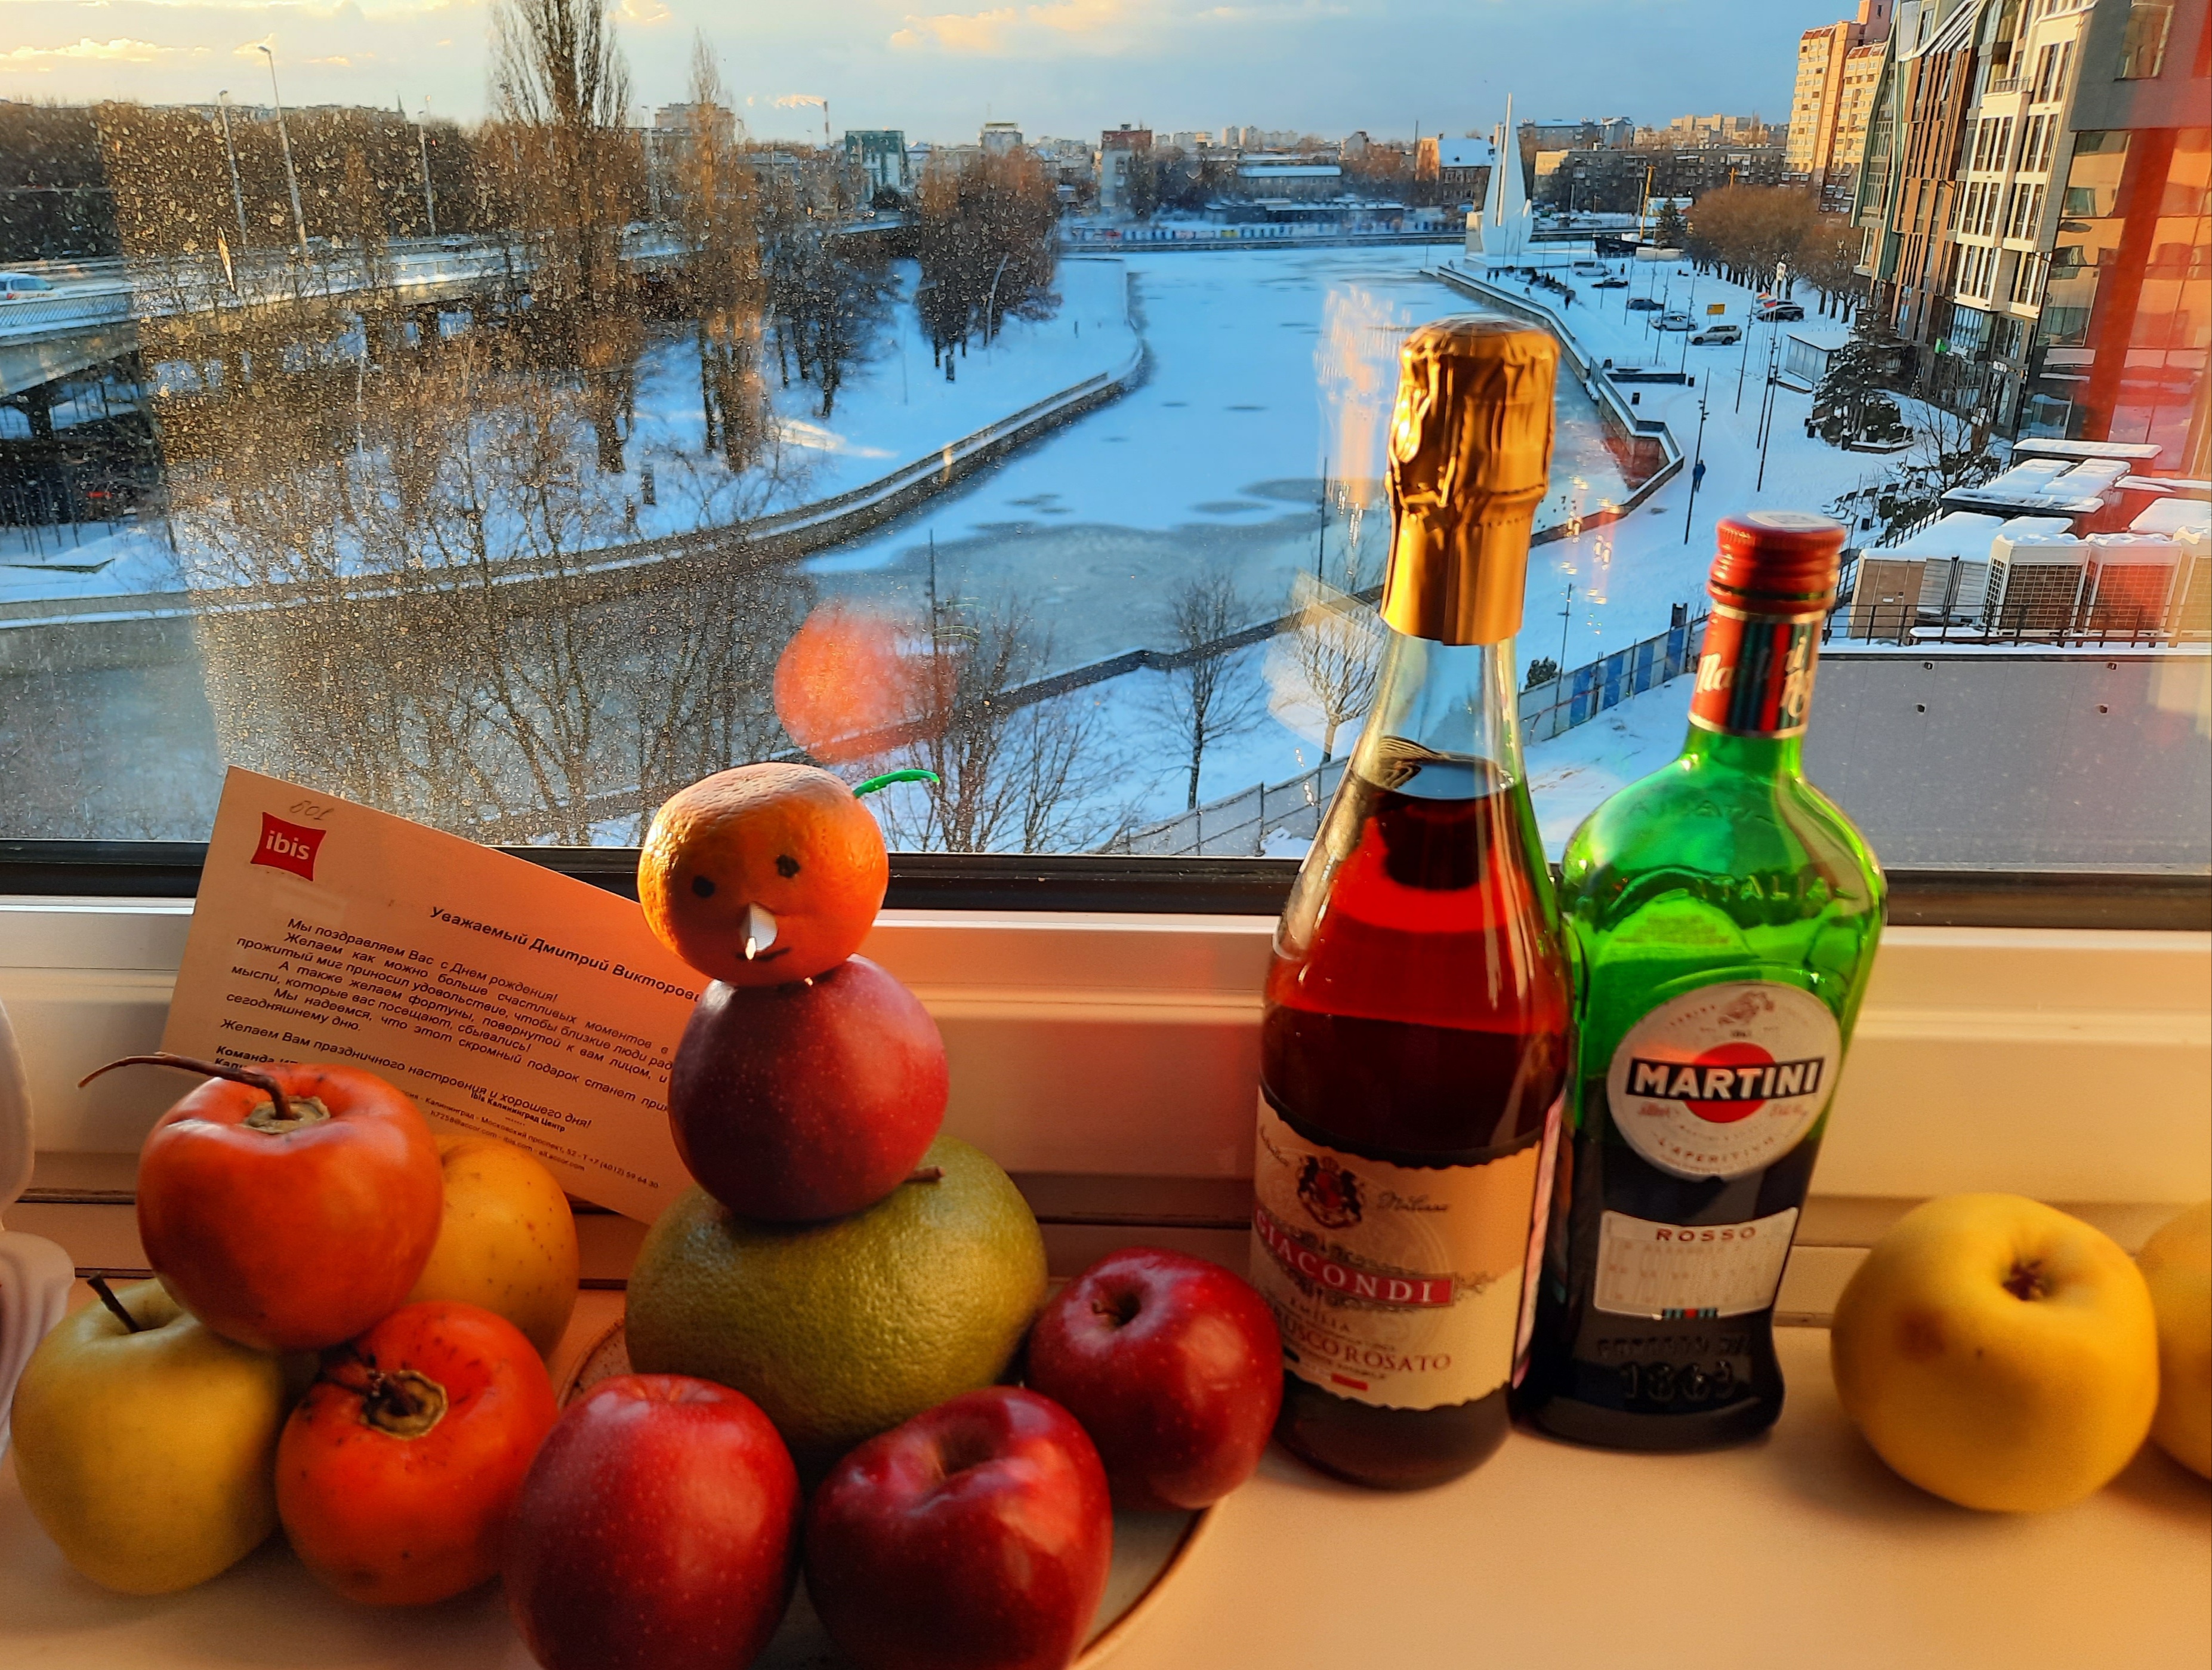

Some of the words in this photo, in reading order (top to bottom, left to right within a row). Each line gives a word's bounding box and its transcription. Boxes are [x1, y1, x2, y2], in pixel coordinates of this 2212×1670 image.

[266, 830, 310, 861] ibis
[287, 918, 312, 932] Мы
[314, 927, 405, 956] поздравляем
[408, 950, 434, 965] Вас
[449, 963, 487, 981] Днем
[488, 976, 558, 1003] рождения!
[430, 906, 528, 945] Уважаемый
[528, 938, 609, 971] Дмитрий
[226, 994, 329, 1024] сегодняшнему
[331, 1015, 360, 1031] дню.
[231, 966, 280, 984] мысли,
[285, 978, 348, 999] которые
[351, 994, 375, 1006] вас
[378, 1001, 452, 1030] посещают,
[458, 1024, 531, 1052] сбывались!
[236, 938, 313, 962] прожитый
[316, 957, 343, 969] миг
[345, 964, 409, 987] приносил
[411, 982, 508, 1018] удовольствие,
[514, 1012, 558, 1031] чтобы
[560, 1025, 610, 1049] близкие
[612, 1045, 647, 1061] люди
[647, 1056, 674, 1073] рад
[277, 961, 288, 970] А
[296, 966, 343, 983] также
[348, 979, 402, 999] желаем
[408, 994, 474, 1022] фортуны,
[482, 1017, 560, 1047] повернутой
[566, 1044, 575, 1052] к
[579, 1048, 604, 1061] вам
[609, 1058, 650, 1079] лицом,
[283, 932, 343, 954] Желаем
[351, 951, 376, 963] как
[384, 960, 428, 977] можно
[437, 973, 488, 995] больше
[497, 993, 577, 1024] счастливых
[584, 1021, 652, 1048] моментов
[220, 1018, 279, 1039] Желаем
[282, 1031, 310, 1046] Вам
[313, 1041, 405, 1070] праздничного
[408, 1066, 487, 1095] настроения
[499, 1093, 562, 1119] хорошего
[564, 1113, 591, 1128] дня!
[273, 988, 298, 1000] Мы
[304, 997, 372, 1021] надеемся,
[381, 1016, 407, 1029] что
[414, 1025, 452, 1042] этот
[458, 1039, 522, 1064] скромный
[526, 1060, 579, 1083] подарок
[584, 1079, 635, 1101] станет
[1634, 1061, 1819, 1100] MARTINI
[487, 1098, 539, 1123] Калининград
[541, 1117, 566, 1132] Центр
[1255, 1209, 1433, 1303] GIACONDI
[1655, 1225, 1756, 1243] ROSSO
